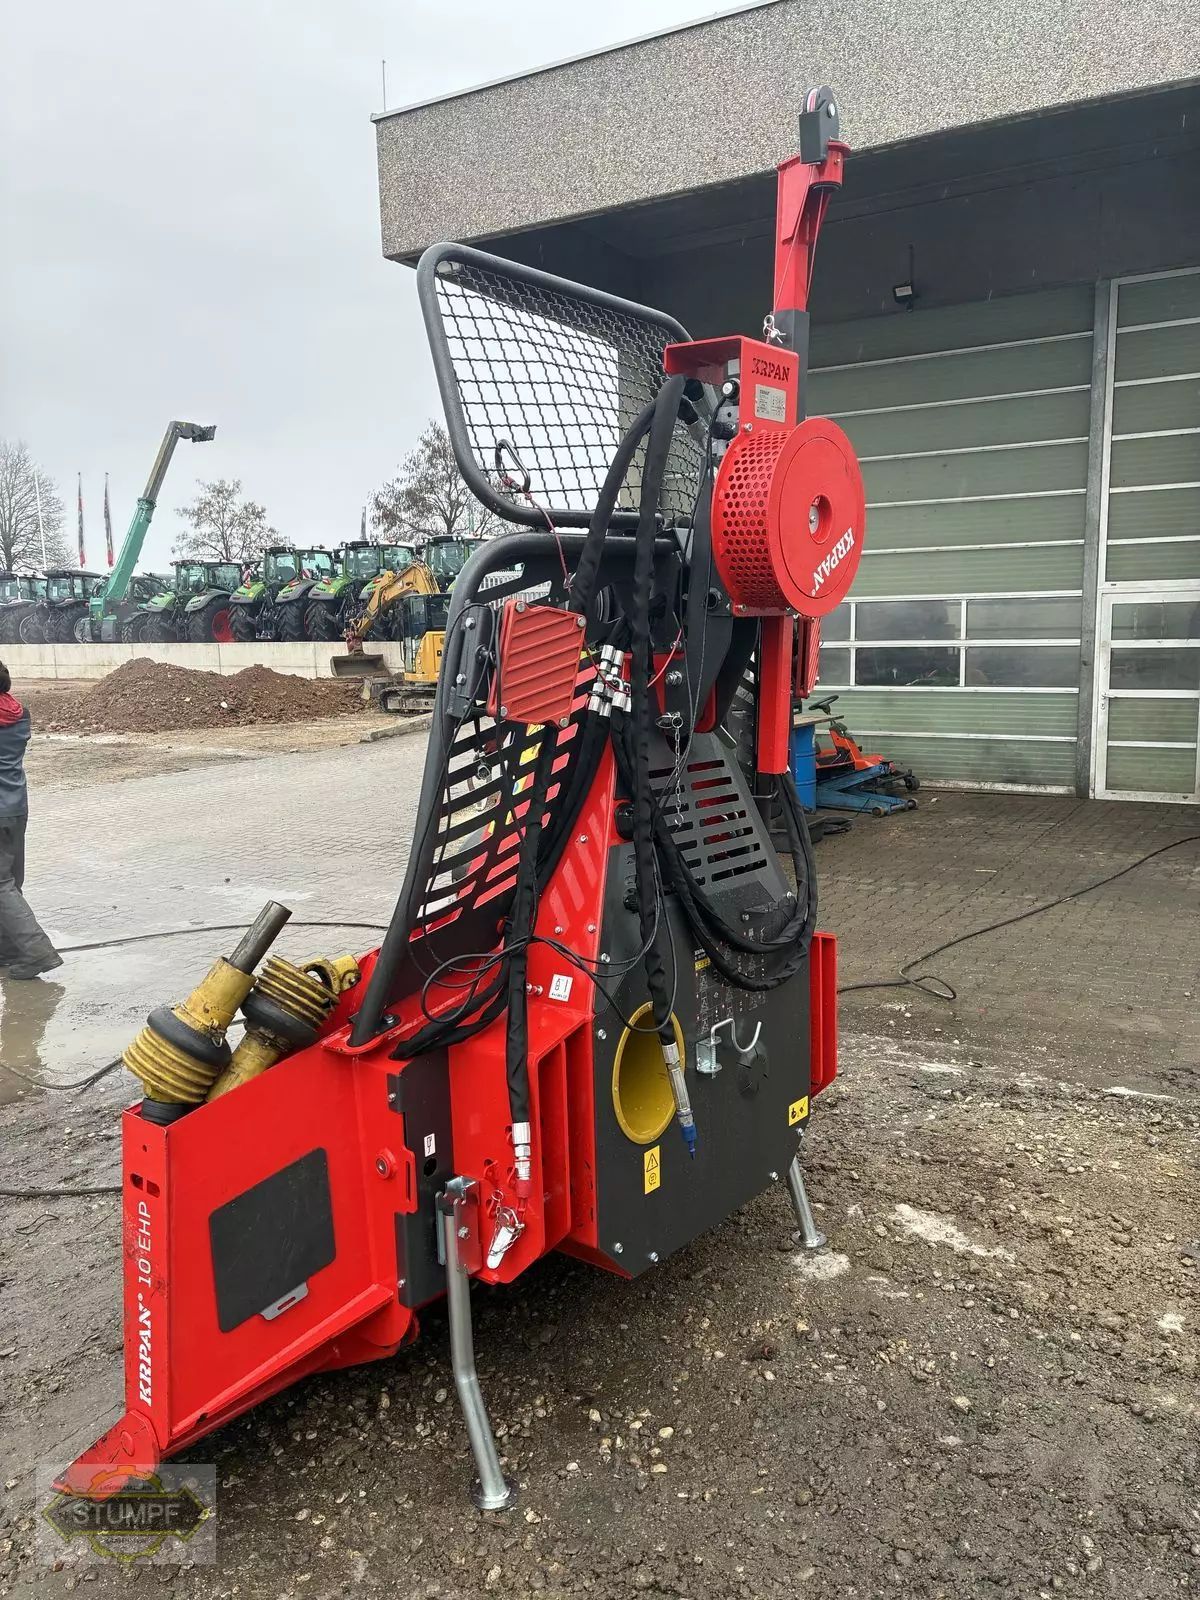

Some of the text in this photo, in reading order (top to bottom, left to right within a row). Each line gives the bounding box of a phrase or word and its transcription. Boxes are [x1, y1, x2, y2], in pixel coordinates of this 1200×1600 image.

[751, 357, 790, 382] KRPAN
[138, 1201, 151, 1252] EHP
[138, 1258, 151, 1288] 10
